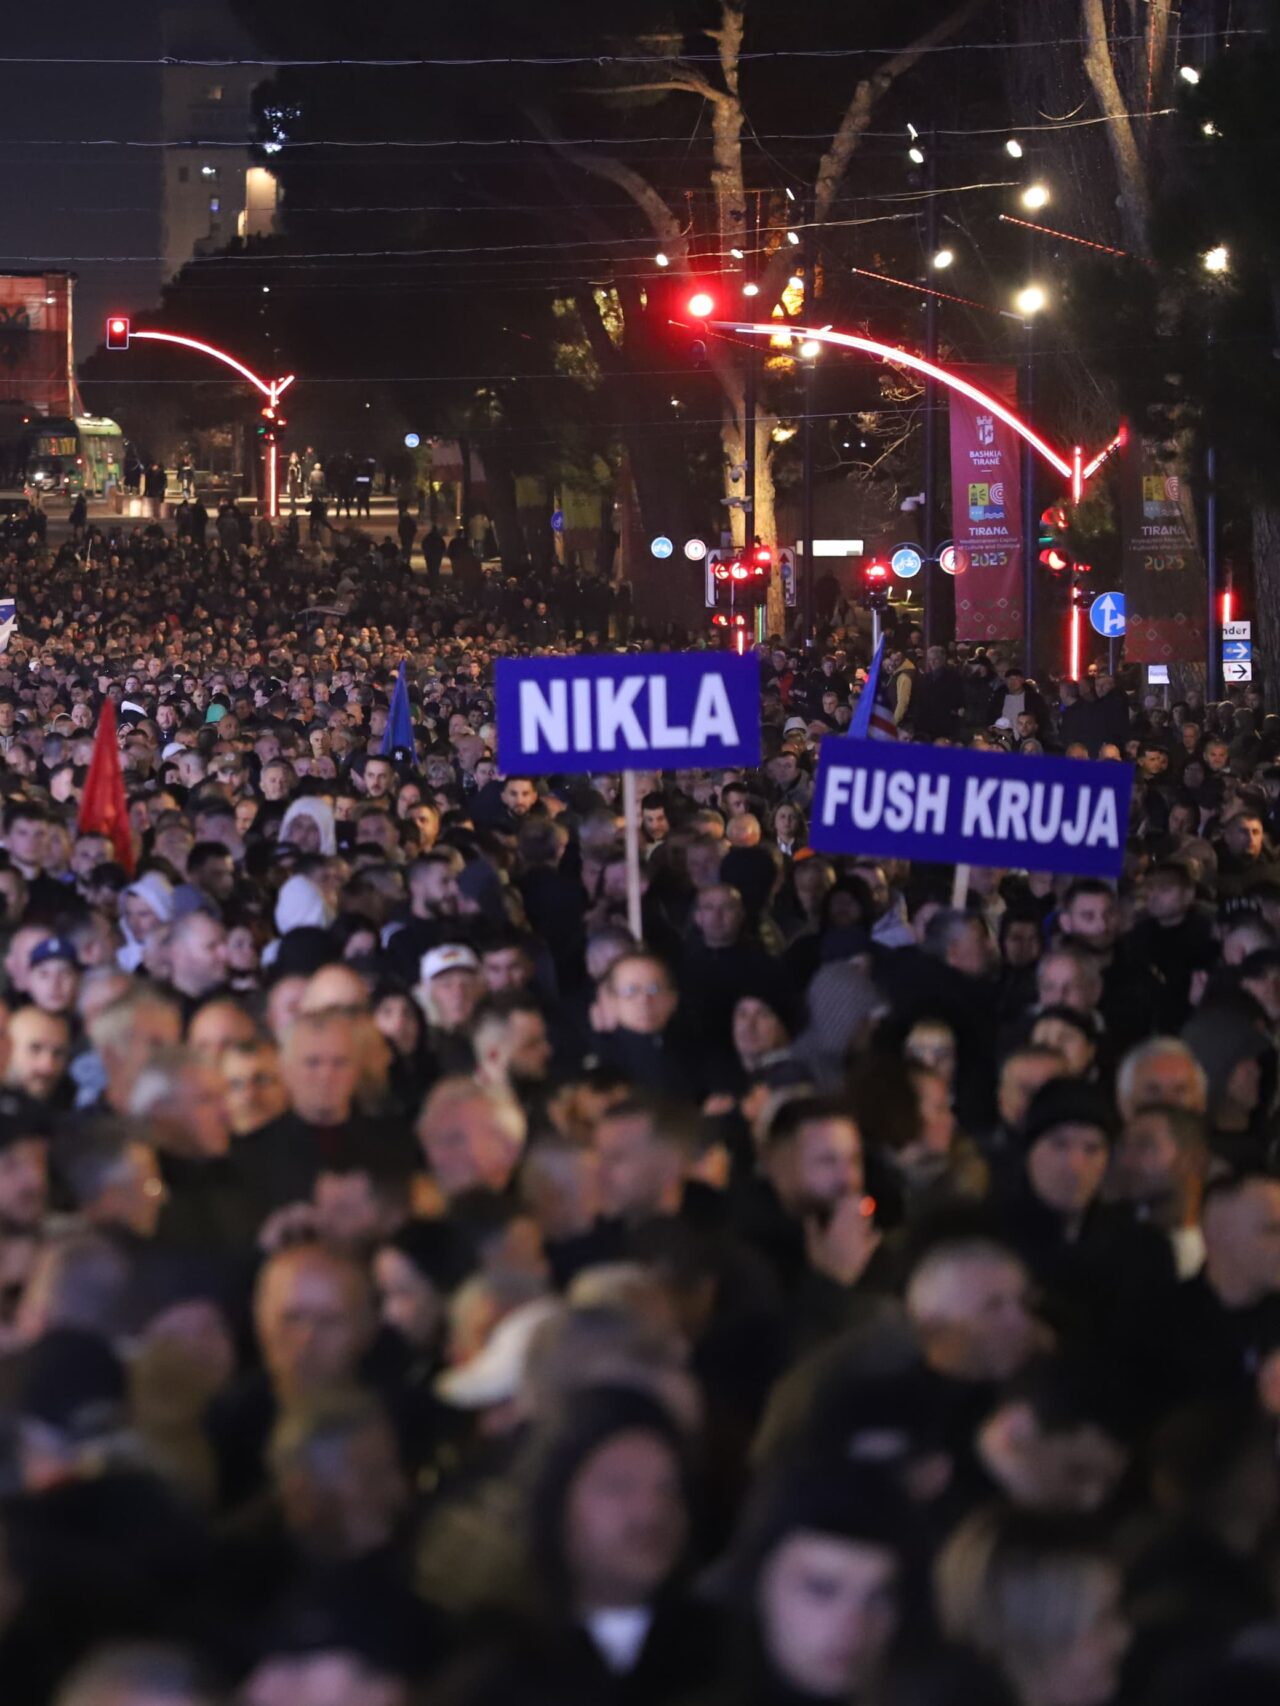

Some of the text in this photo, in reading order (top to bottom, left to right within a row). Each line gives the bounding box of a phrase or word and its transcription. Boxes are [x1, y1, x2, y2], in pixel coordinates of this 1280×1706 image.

[969, 450, 1002, 458] BASHKIA
[969, 526, 1008, 536] TIRANA
[1141, 525, 1186, 536] TIRANA
[971, 551, 1008, 567] 2025
[1144, 555, 1185, 571] 2025
[519, 672, 740, 754] NIKLA
[822, 765, 1119, 848] FUSH KRUJA
